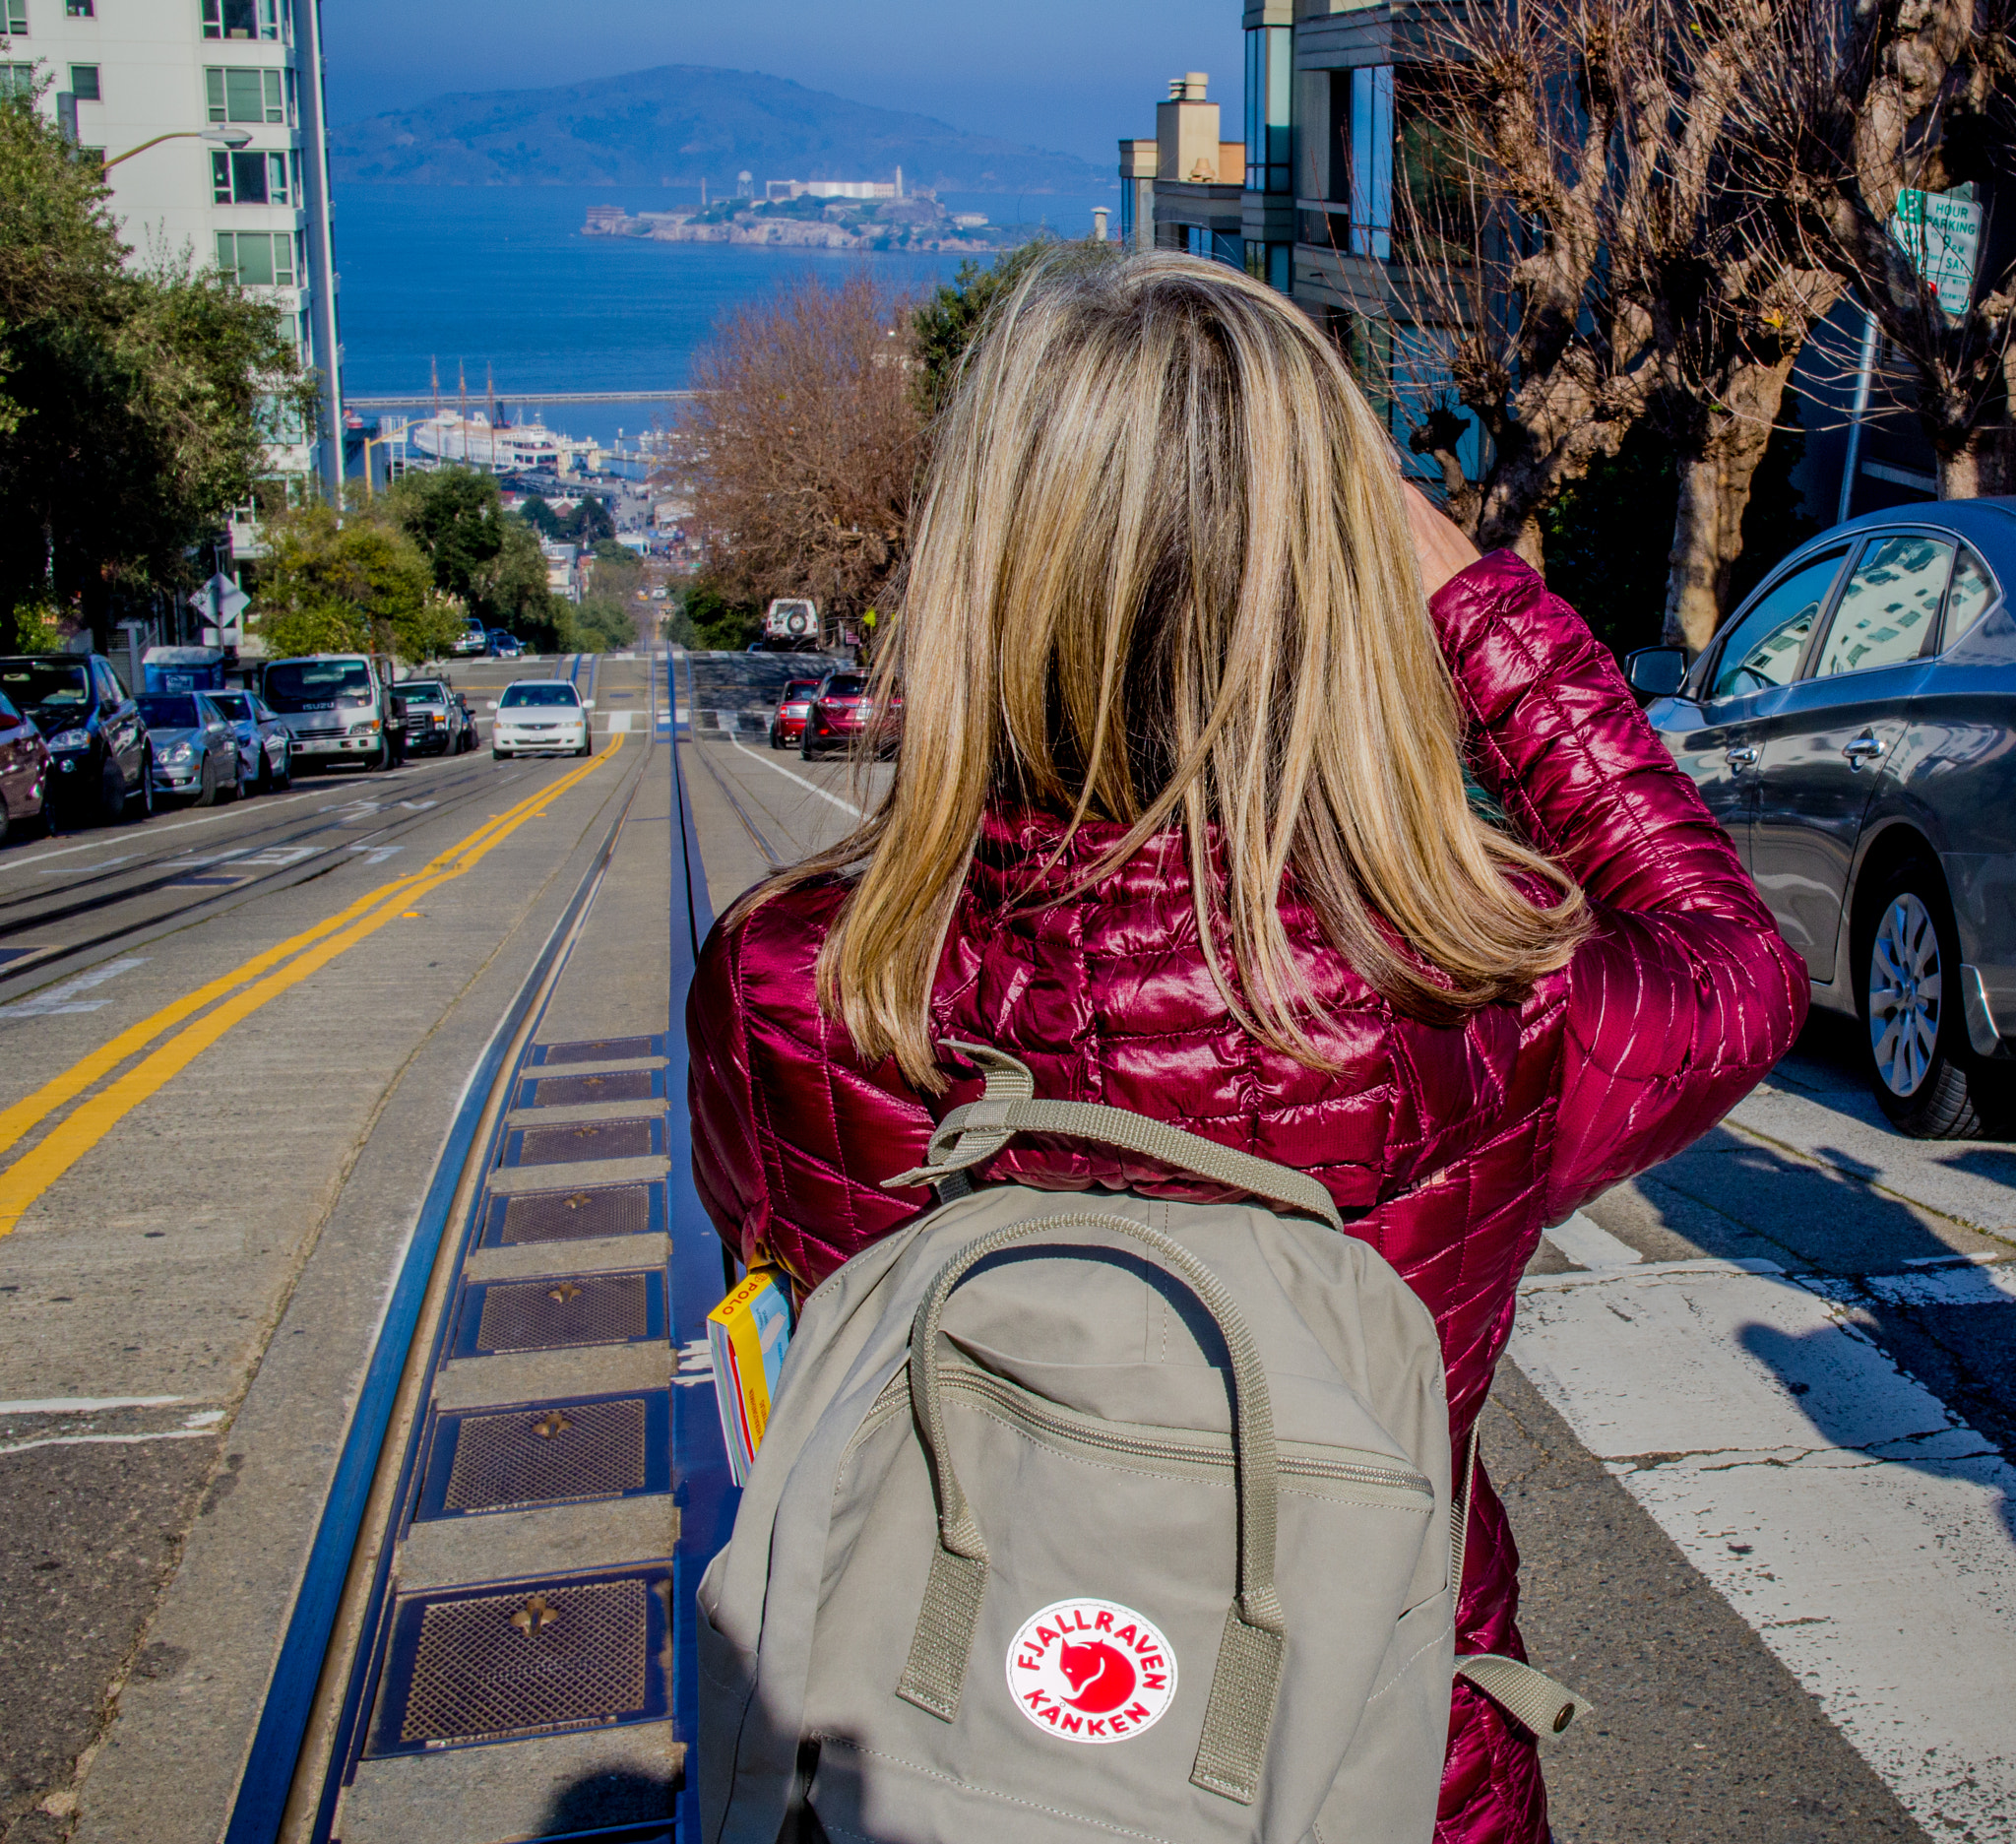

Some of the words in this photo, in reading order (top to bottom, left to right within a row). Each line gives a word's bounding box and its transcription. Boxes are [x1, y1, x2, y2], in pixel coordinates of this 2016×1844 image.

[1904, 195, 1919, 218] 2
[1935, 203, 1969, 219] HOUR
[1925, 215, 1976, 235] PARKING
[1945, 257, 1966, 271] SAT
[1941, 291, 1965, 302] PERMITS
[302, 701, 335, 711] ISUZU
[723, 1282, 758, 1315] POLO
